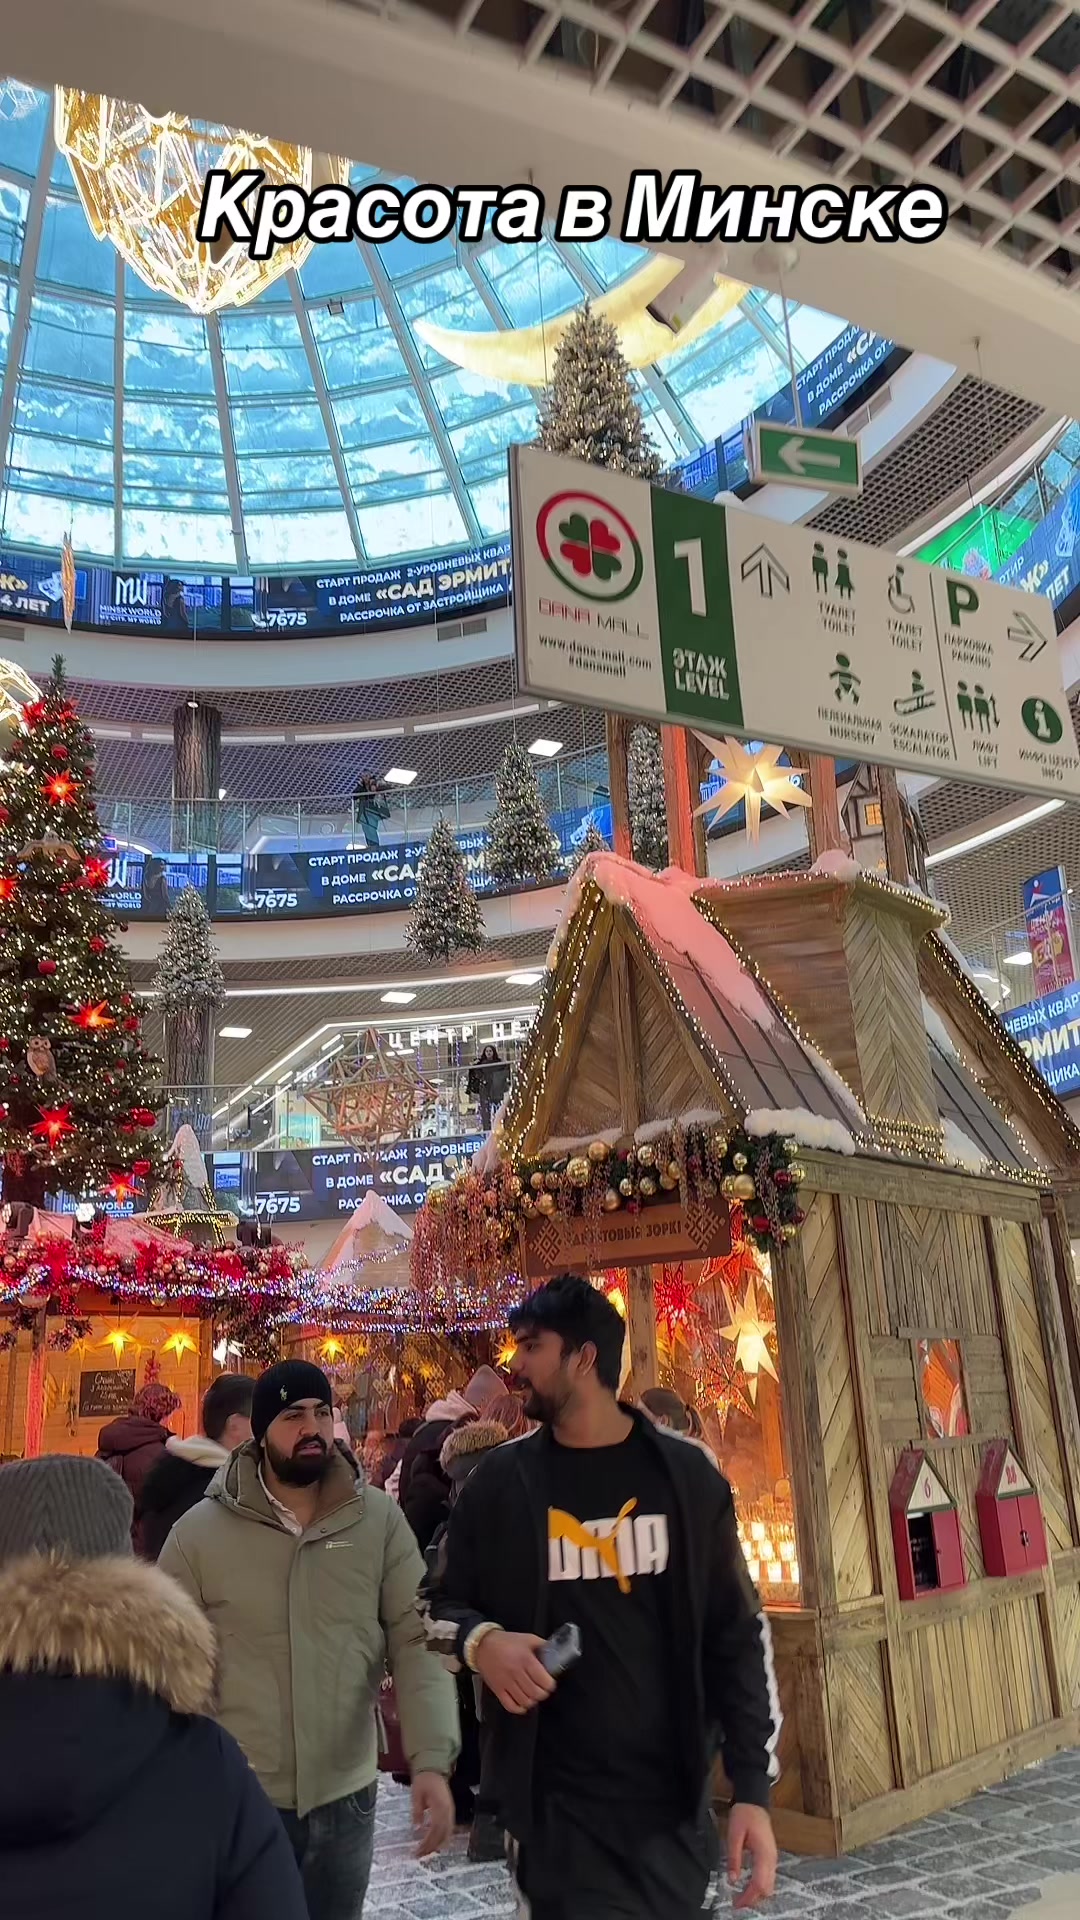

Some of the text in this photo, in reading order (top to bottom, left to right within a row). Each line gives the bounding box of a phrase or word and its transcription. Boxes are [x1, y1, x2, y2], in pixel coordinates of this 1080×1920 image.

[796, 358, 823, 391] СТАРТ
[807, 392, 815, 403] В
[815, 363, 844, 398] ДОМЕ
[819, 339, 887, 416] РАССРОЧКА ОТ
[316, 544, 511, 590] СТАРТ ПРОДАЖ 2-УРОВНЕВЫХ КВАР
[674, 537, 707, 617] 1
[999, 556, 1025, 584] РТИР
[329, 559, 512, 606] В ДОМЕ «САД ЭРМИТ
[16, 597, 49, 613] ЛЕТ
[100, 605, 162, 617] MINSK WORLD
[340, 583, 503, 623] РАССРОЧКА ОТ ЗАСТРОЙЩИКА
[818, 600, 855, 621] ТУАЛЕТ
[139, 617, 162, 625] WORLD
[267, 612, 307, 627] 7675
[539, 597, 649, 640] DANA MALL
[822, 618, 855, 636] TOILET
[887, 617, 922, 637] ТУАЛЕТ
[890, 634, 922, 653] TOILET
[944, 632, 994, 655] ПАРКОВКА
[569, 655, 626, 678] #danamall
[673, 648, 728, 679] ЭТАЖ
[952, 650, 991, 669] PARKING
[675, 669, 730, 700] LEVEL
[829, 725, 876, 745] NURSERY
[889, 721, 949, 745] ЭСКАЛАТОР
[893, 738, 950, 760] ESCALATOR
[973, 739, 1000, 755] ЛИФТ
[979, 755, 998, 769] LIFT
[1041, 768, 1063, 781] INFO
[308, 855, 345, 868] СТАРТ
[347, 849, 399, 866] ПРОДАЖ
[321, 876, 330, 886] В
[332, 872, 367, 887] ДОМЕ
[254, 893, 298, 908] 7675
[333, 890, 401, 905] РАССРОЧКА
[1048, 991, 1080, 1018] КВАР
[312, 1153, 351, 1166] СТАРТ
[326, 1162, 445, 1189] В ДОМЕ «САД
[255, 1196, 301, 1215] 7675
[646, 1221, 682, 1237] ЗОРКІ
[923, 1477, 932, 1499] 6
